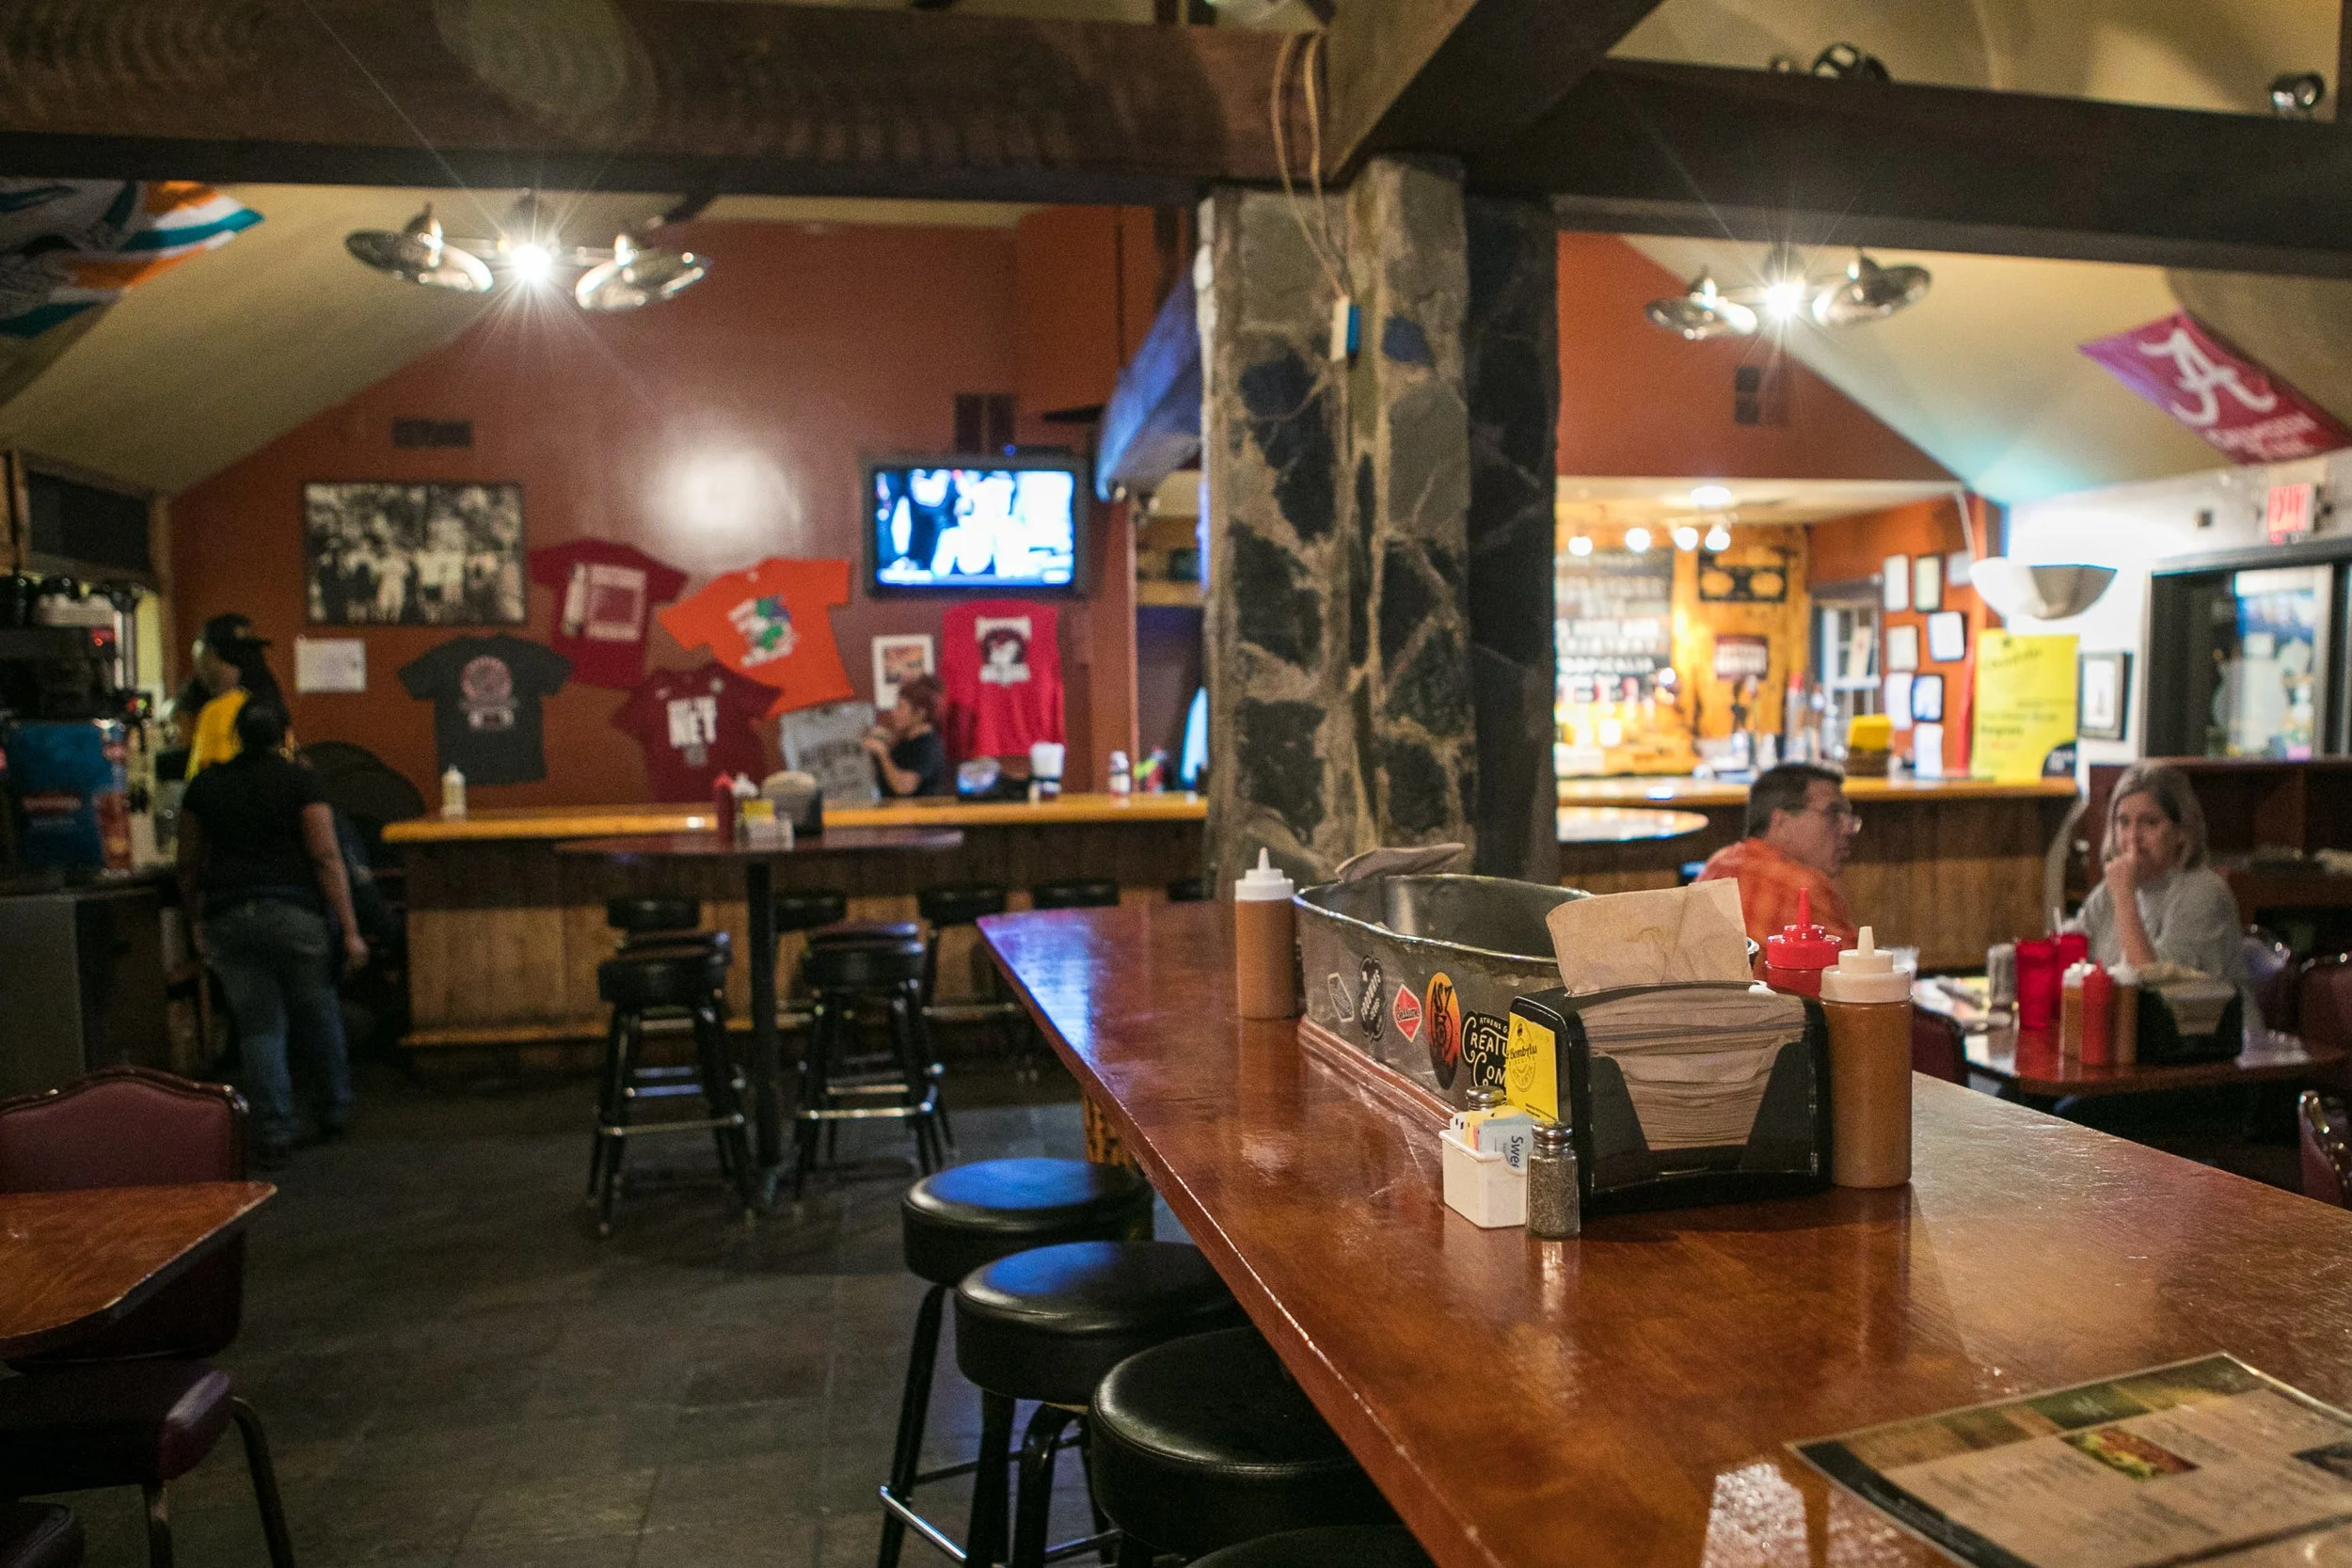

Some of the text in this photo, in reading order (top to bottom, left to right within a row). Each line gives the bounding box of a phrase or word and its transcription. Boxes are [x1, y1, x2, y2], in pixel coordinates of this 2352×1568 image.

[1462, 1016, 1508, 1063] CREATU
[1480, 1017, 1510, 1036] ATHENS G
